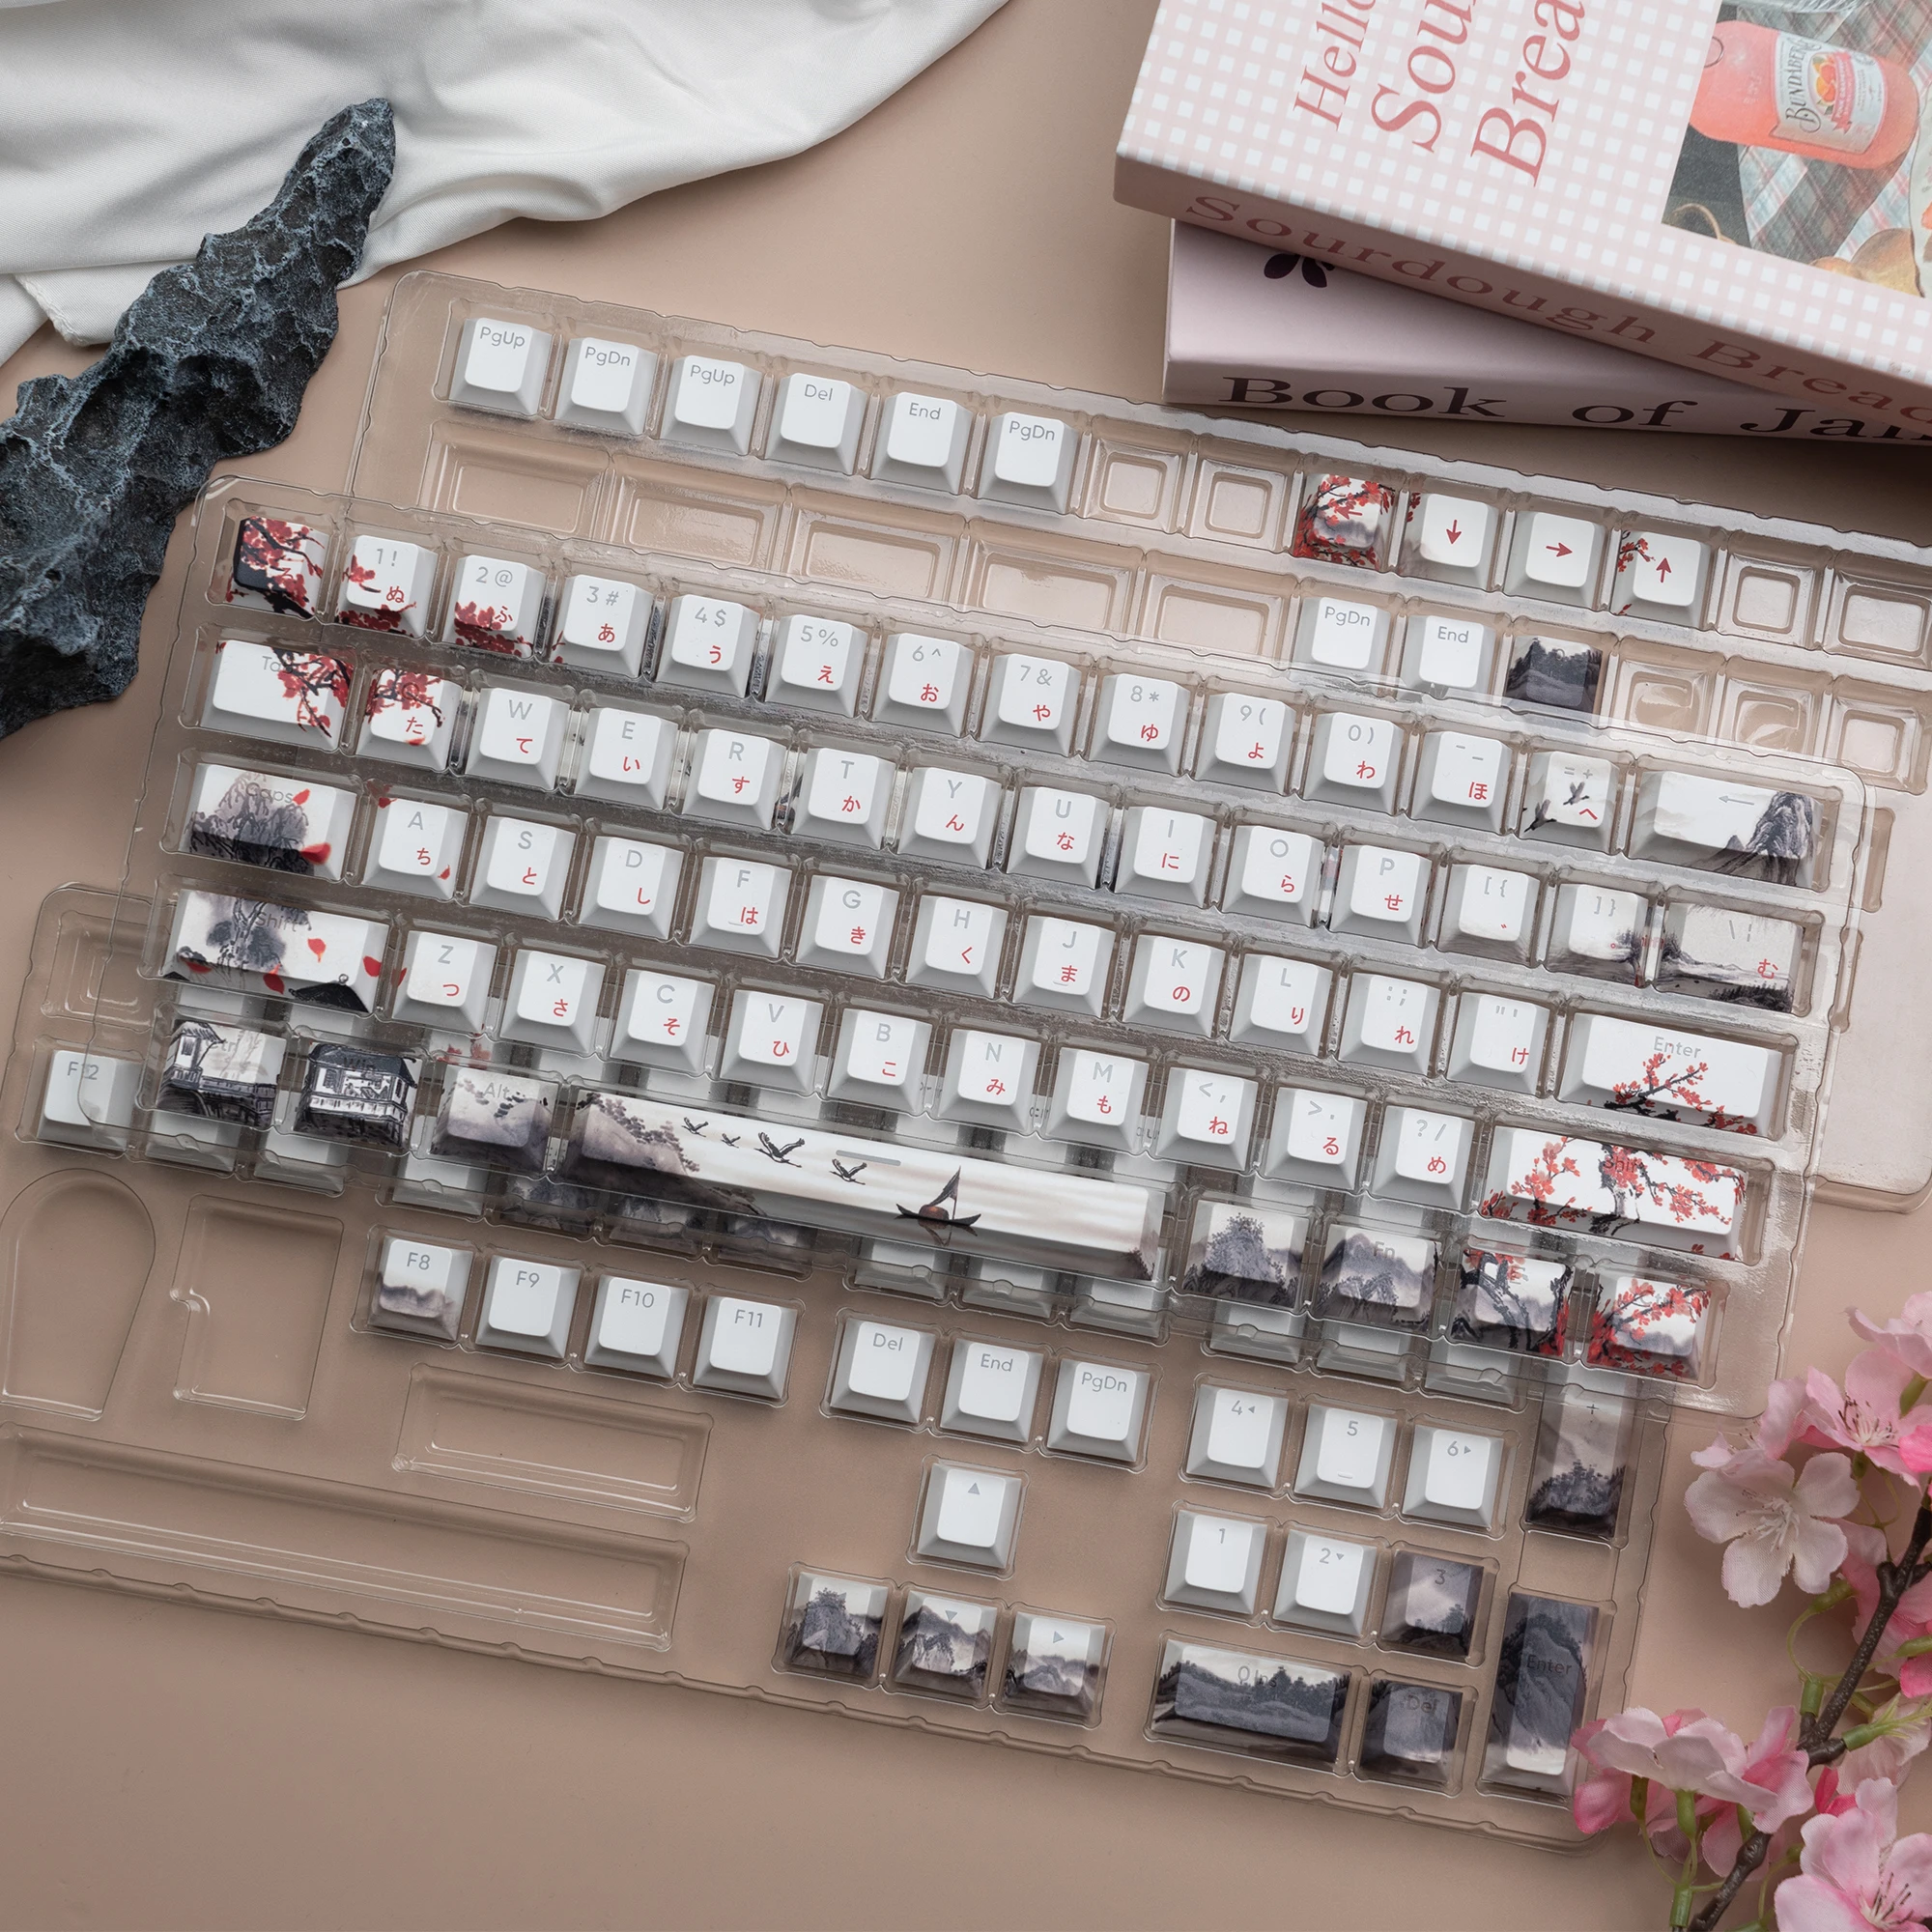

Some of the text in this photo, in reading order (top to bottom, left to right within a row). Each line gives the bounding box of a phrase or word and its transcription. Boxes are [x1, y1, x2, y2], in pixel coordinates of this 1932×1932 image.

[1470, 0, 1585, 187] Brea
[1185, 196, 1657, 344] Sourdough
[480, 323, 529, 349] PgUp
[585, 342, 634, 366] PgDn
[691, 360, 739, 386] PgUp
[805, 384, 833, 401] Del
[1222, 376, 1507, 417] Book
[1572, 401, 1698, 427] of
[909, 403, 941, 419] End
[1009, 417, 1059, 440] PgDn
[377, 549, 397, 566] 1!
[476, 567, 513, 587] 2@
[386, 586, 405, 603] ぬ
[586, 586, 618, 606] 3#
[496, 607, 513, 623] ふ
[695, 607, 726, 627] 4$
[1325, 603, 1374, 626] PgDn
[598, 623, 614, 642] あ
[801, 625, 838, 646] 5%
[1438, 626, 1468, 643] End
[710, 645, 721, 664] う
[913, 645, 941, 662] 6^
[262, 656, 289, 673] Ta
[818, 666, 834, 684] え
[1021, 665, 1052, 686] 7&
[921, 684, 939, 702] お
[509, 699, 532, 720] W
[1033, 705, 1050, 722] や
[1240, 705, 1265, 725] 9(
[406, 718, 423, 735] た
[622, 721, 636, 740] E
[1141, 724, 1158, 742] ゆ
[1349, 724, 1374, 744] 0)
[517, 738, 532, 753] て
[728, 742, 744, 761] R
[1248, 743, 1264, 758] よ
[623, 756, 639, 771] い
[841, 760, 854, 779] T
[1356, 761, 1375, 779] わ
[732, 777, 750, 793] す
[948, 780, 962, 799] Y
[1469, 781, 1488, 800] ほ
[842, 796, 861, 812] か
[1056, 799, 1071, 818] U
[408, 811, 423, 830] A
[946, 814, 964, 831] ん
[1579, 809, 1598, 820] へ
[518, 831, 532, 849] S
[1057, 833, 1074, 850] な
[1270, 839, 1289, 858] O
[417, 848, 431, 866] ち
[626, 849, 642, 867] D
[1162, 853, 1179, 869] に
[1379, 858, 1395, 875] P
[523, 867, 537, 885] と
[737, 869, 751, 888] F
[1281, 875, 1294, 893] ら
[1485, 876, 1508, 897] [{
[638, 888, 650, 904] し
[842, 890, 861, 909] G
[1384, 895, 1403, 911] せ
[1595, 896, 1617, 917] ]}
[740, 907, 759, 925] は
[953, 909, 971, 928] H
[851, 926, 866, 945] き
[1063, 931, 1077, 949] J
[438, 945, 453, 964] Z
[962, 947, 972, 964] く
[1172, 949, 1187, 969] K
[547, 963, 564, 983] X
[1061, 966, 1078, 983] ま
[1281, 968, 1292, 987] L
[1757, 958, 1778, 980] む
[443, 984, 459, 996] つ
[657, 984, 675, 1004] C
[1173, 986, 1190, 1002] の
[554, 999, 568, 1016] さ
[769, 1004, 784, 1022] V
[1292, 1008, 1304, 1025] り
[664, 1018, 680, 1036] そ
[876, 1023, 891, 1042] B
[1395, 1026, 1414, 1044] れ
[773, 1041, 789, 1057] ひ
[985, 1042, 1002, 1062] N
[1512, 1047, 1529, 1065] け
[1654, 1037, 1701, 1059] Enter
[882, 1062, 895, 1076] こ
[1093, 1062, 1113, 1083] M
[483, 1082, 511, 1100] Alt
[986, 1079, 1005, 1094] み
[1097, 1095, 1111, 1114] も
[1208, 1117, 1228, 1134] ね
[1323, 1137, 1339, 1155] る
[1428, 1156, 1446, 1174] め
[1603, 1157, 1648, 1174] Shif
[407, 1252, 430, 1270] F8
[516, 1270, 539, 1288] F9
[621, 1289, 654, 1308] F10
[735, 1309, 762, 1327] F11
[873, 1329, 907, 1350] Del
[980, 1350, 1016, 1372] End
[1082, 1369, 1131, 1392] PgDn
[1232, 1400, 1242, 1415] 4
[1348, 1420, 1358, 1435] 5
[1447, 1440, 1460, 1457] 6
[1219, 1528, 1226, 1544] 1
[1320, 1548, 1331, 1564] 2
[1435, 1568, 1447, 1585] 3
[1526, 1655, 1573, 1675] Enter
